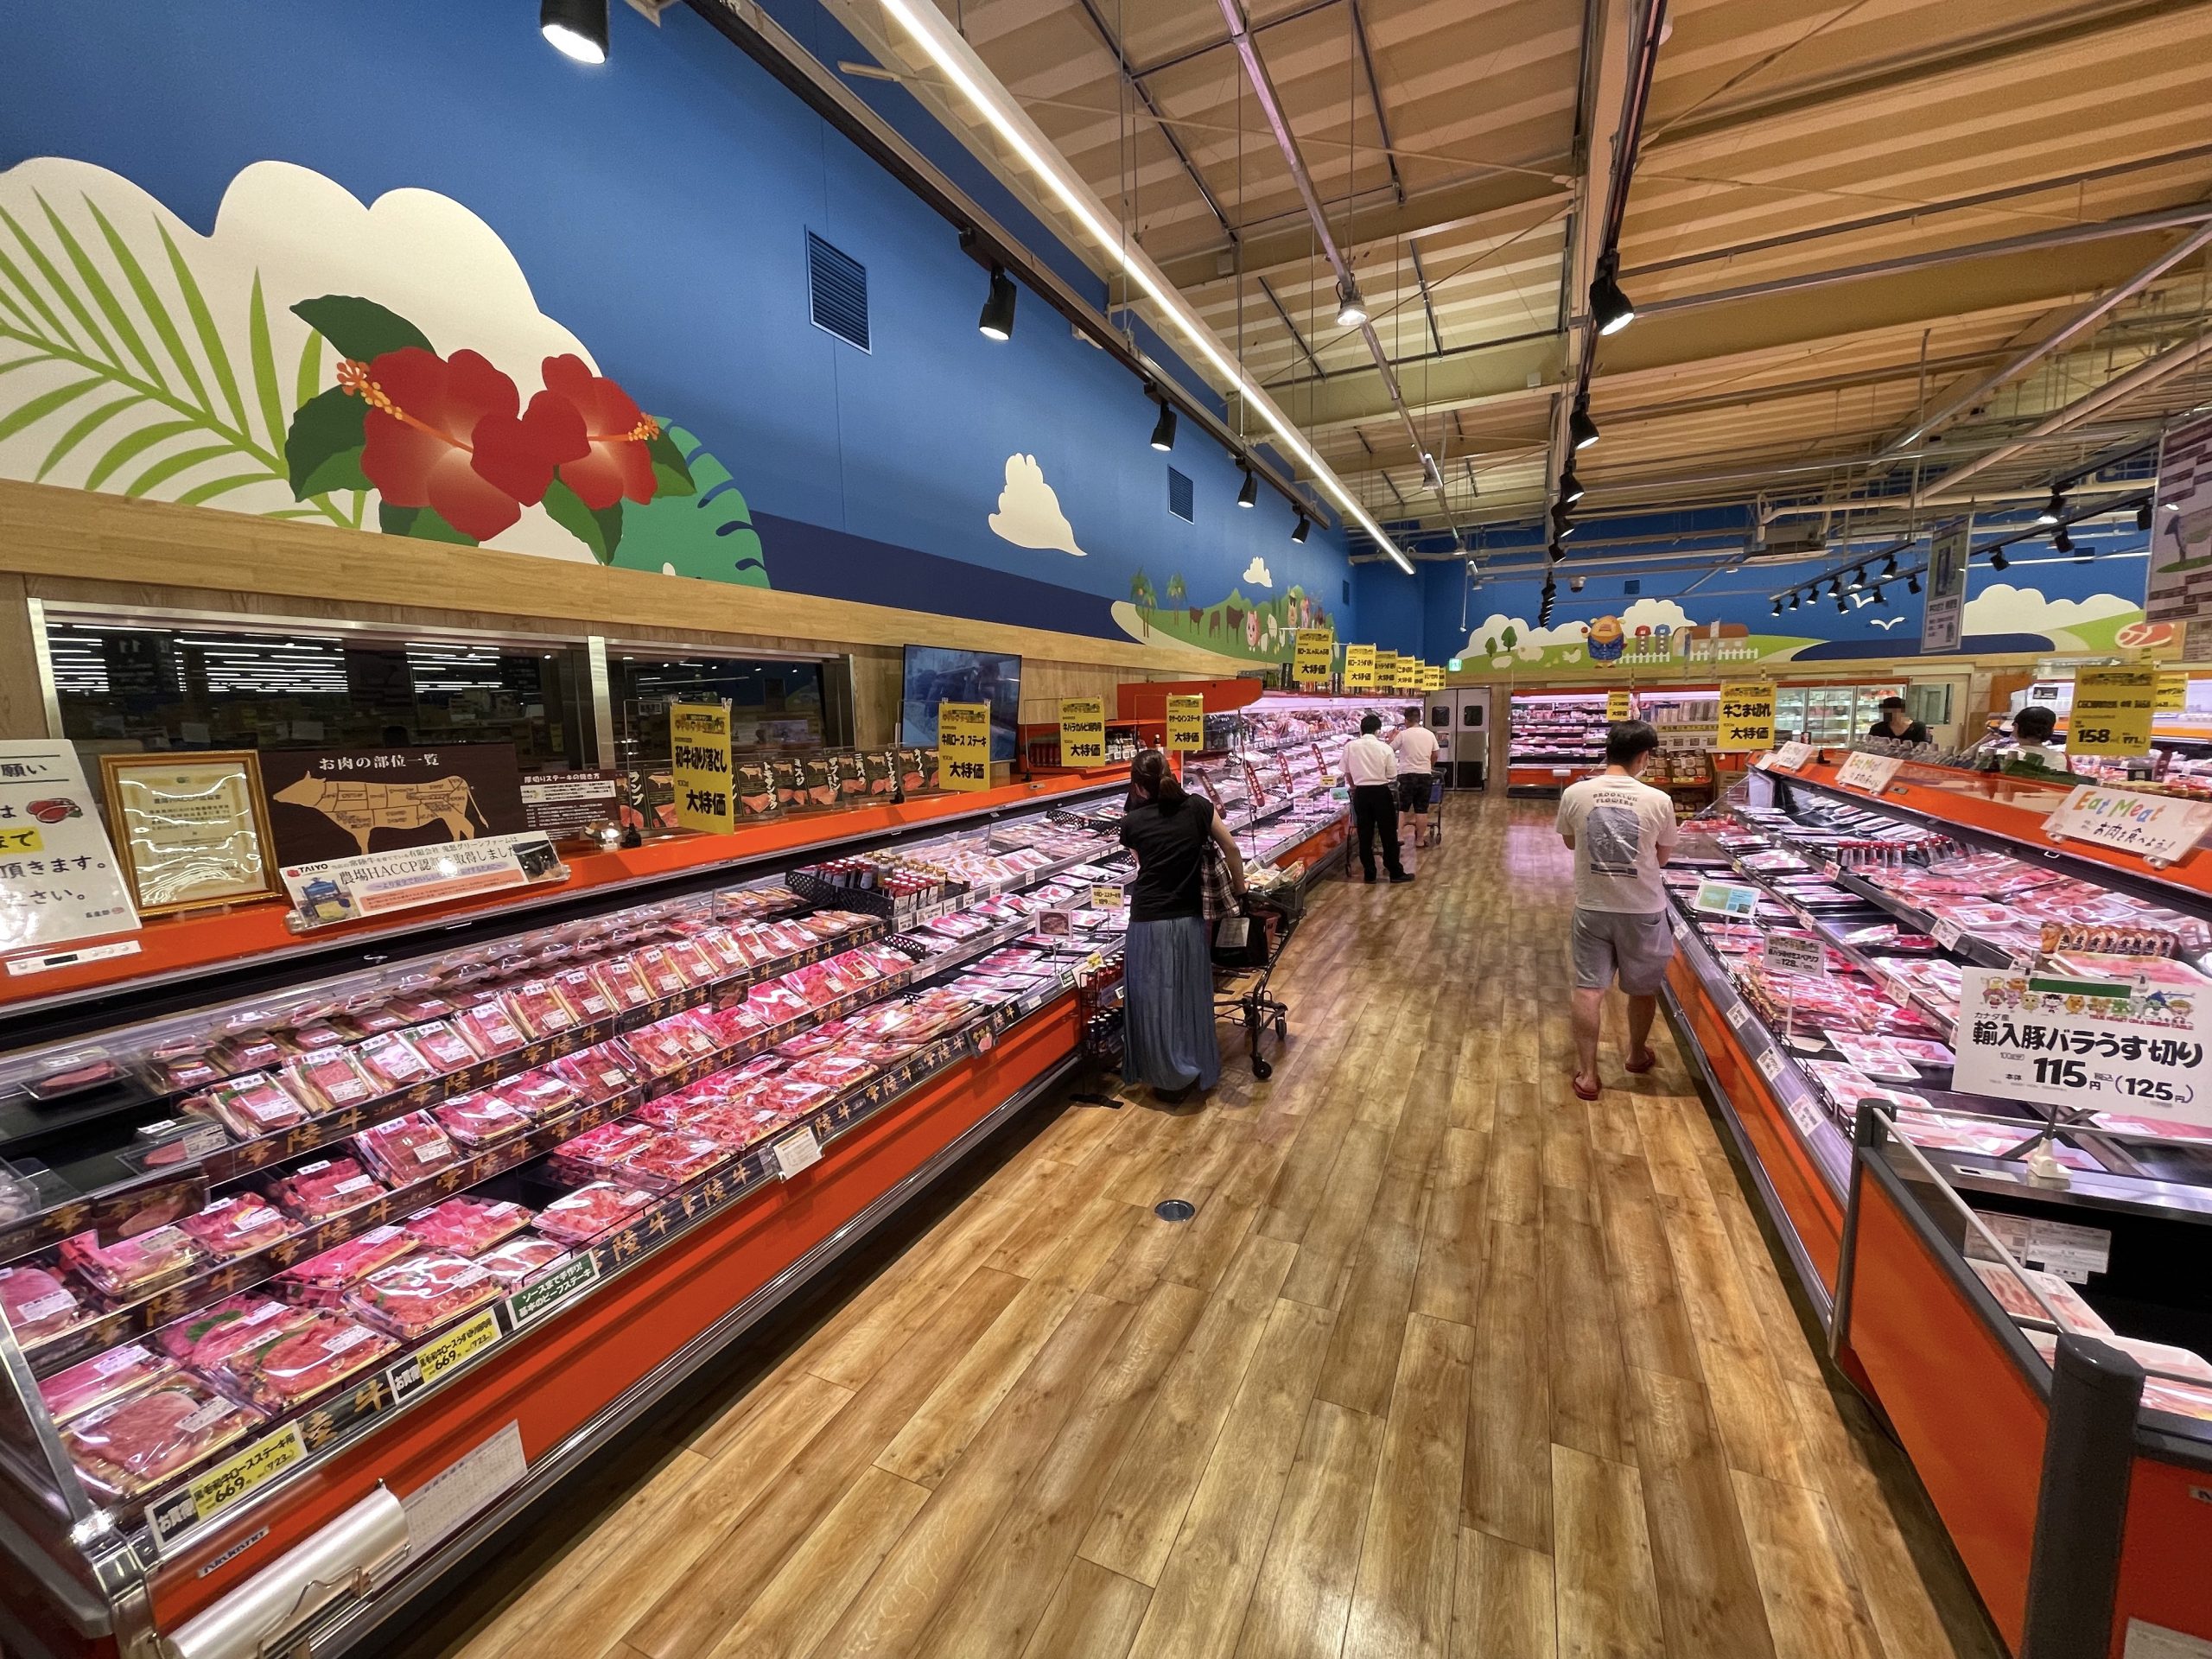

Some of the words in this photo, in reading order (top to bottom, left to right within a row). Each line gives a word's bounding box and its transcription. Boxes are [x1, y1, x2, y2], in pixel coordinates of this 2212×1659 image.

[1301, 664, 1326, 674] 大特価
[1723, 703, 1771, 718] 牛こま切れ
[968, 736, 986, 747] ステーキ
[1175, 733, 1199, 742] 大特価
[1731, 728, 1769, 740] 大特価
[2077, 729, 2110, 743] 158
[319, 753, 439, 771] お肉の部位一覧
[675, 746, 728, 772] 和牛切り落とし
[1071, 744, 1100, 756] 大特価
[2, 763, 48, 777] 願い
[794, 759, 804, 785] ミスジ
[950, 762, 984, 779] 大特価
[686, 790, 726, 816] 大特価
[2073, 791, 2112, 815] Eat
[2108, 798, 2167, 823] Meat
[298, 863, 328, 874] TAIYO
[1974, 1012, 2009, 1021] カナダ産
[522, 1025, 601, 1065] 常陸牛
[1973, 1020, 2202, 1069] 輸入豚バラうす切り
[408, 1059, 505, 1105] 常陸牛
[2033, 1058, 2087, 1088] 115
[551, 1096, 629, 1140] 常陸牛
[239, 1108, 367, 1166] 常陸牛
[436, 1138, 532, 1191] 常陸牛
[271, 1199, 394, 1265] 常陸牛
[518, 1268, 593, 1318] 基本のビーフステーキ
[522, 1262, 582, 1302] ソースまで手作り!
[435, 1350, 457, 1371] 669
[194, 1433, 296, 1502] 黒毛和牛ロースステーキ用
[215, 1476, 245, 1503] 669
[158, 1497, 196, 1534] お買得
